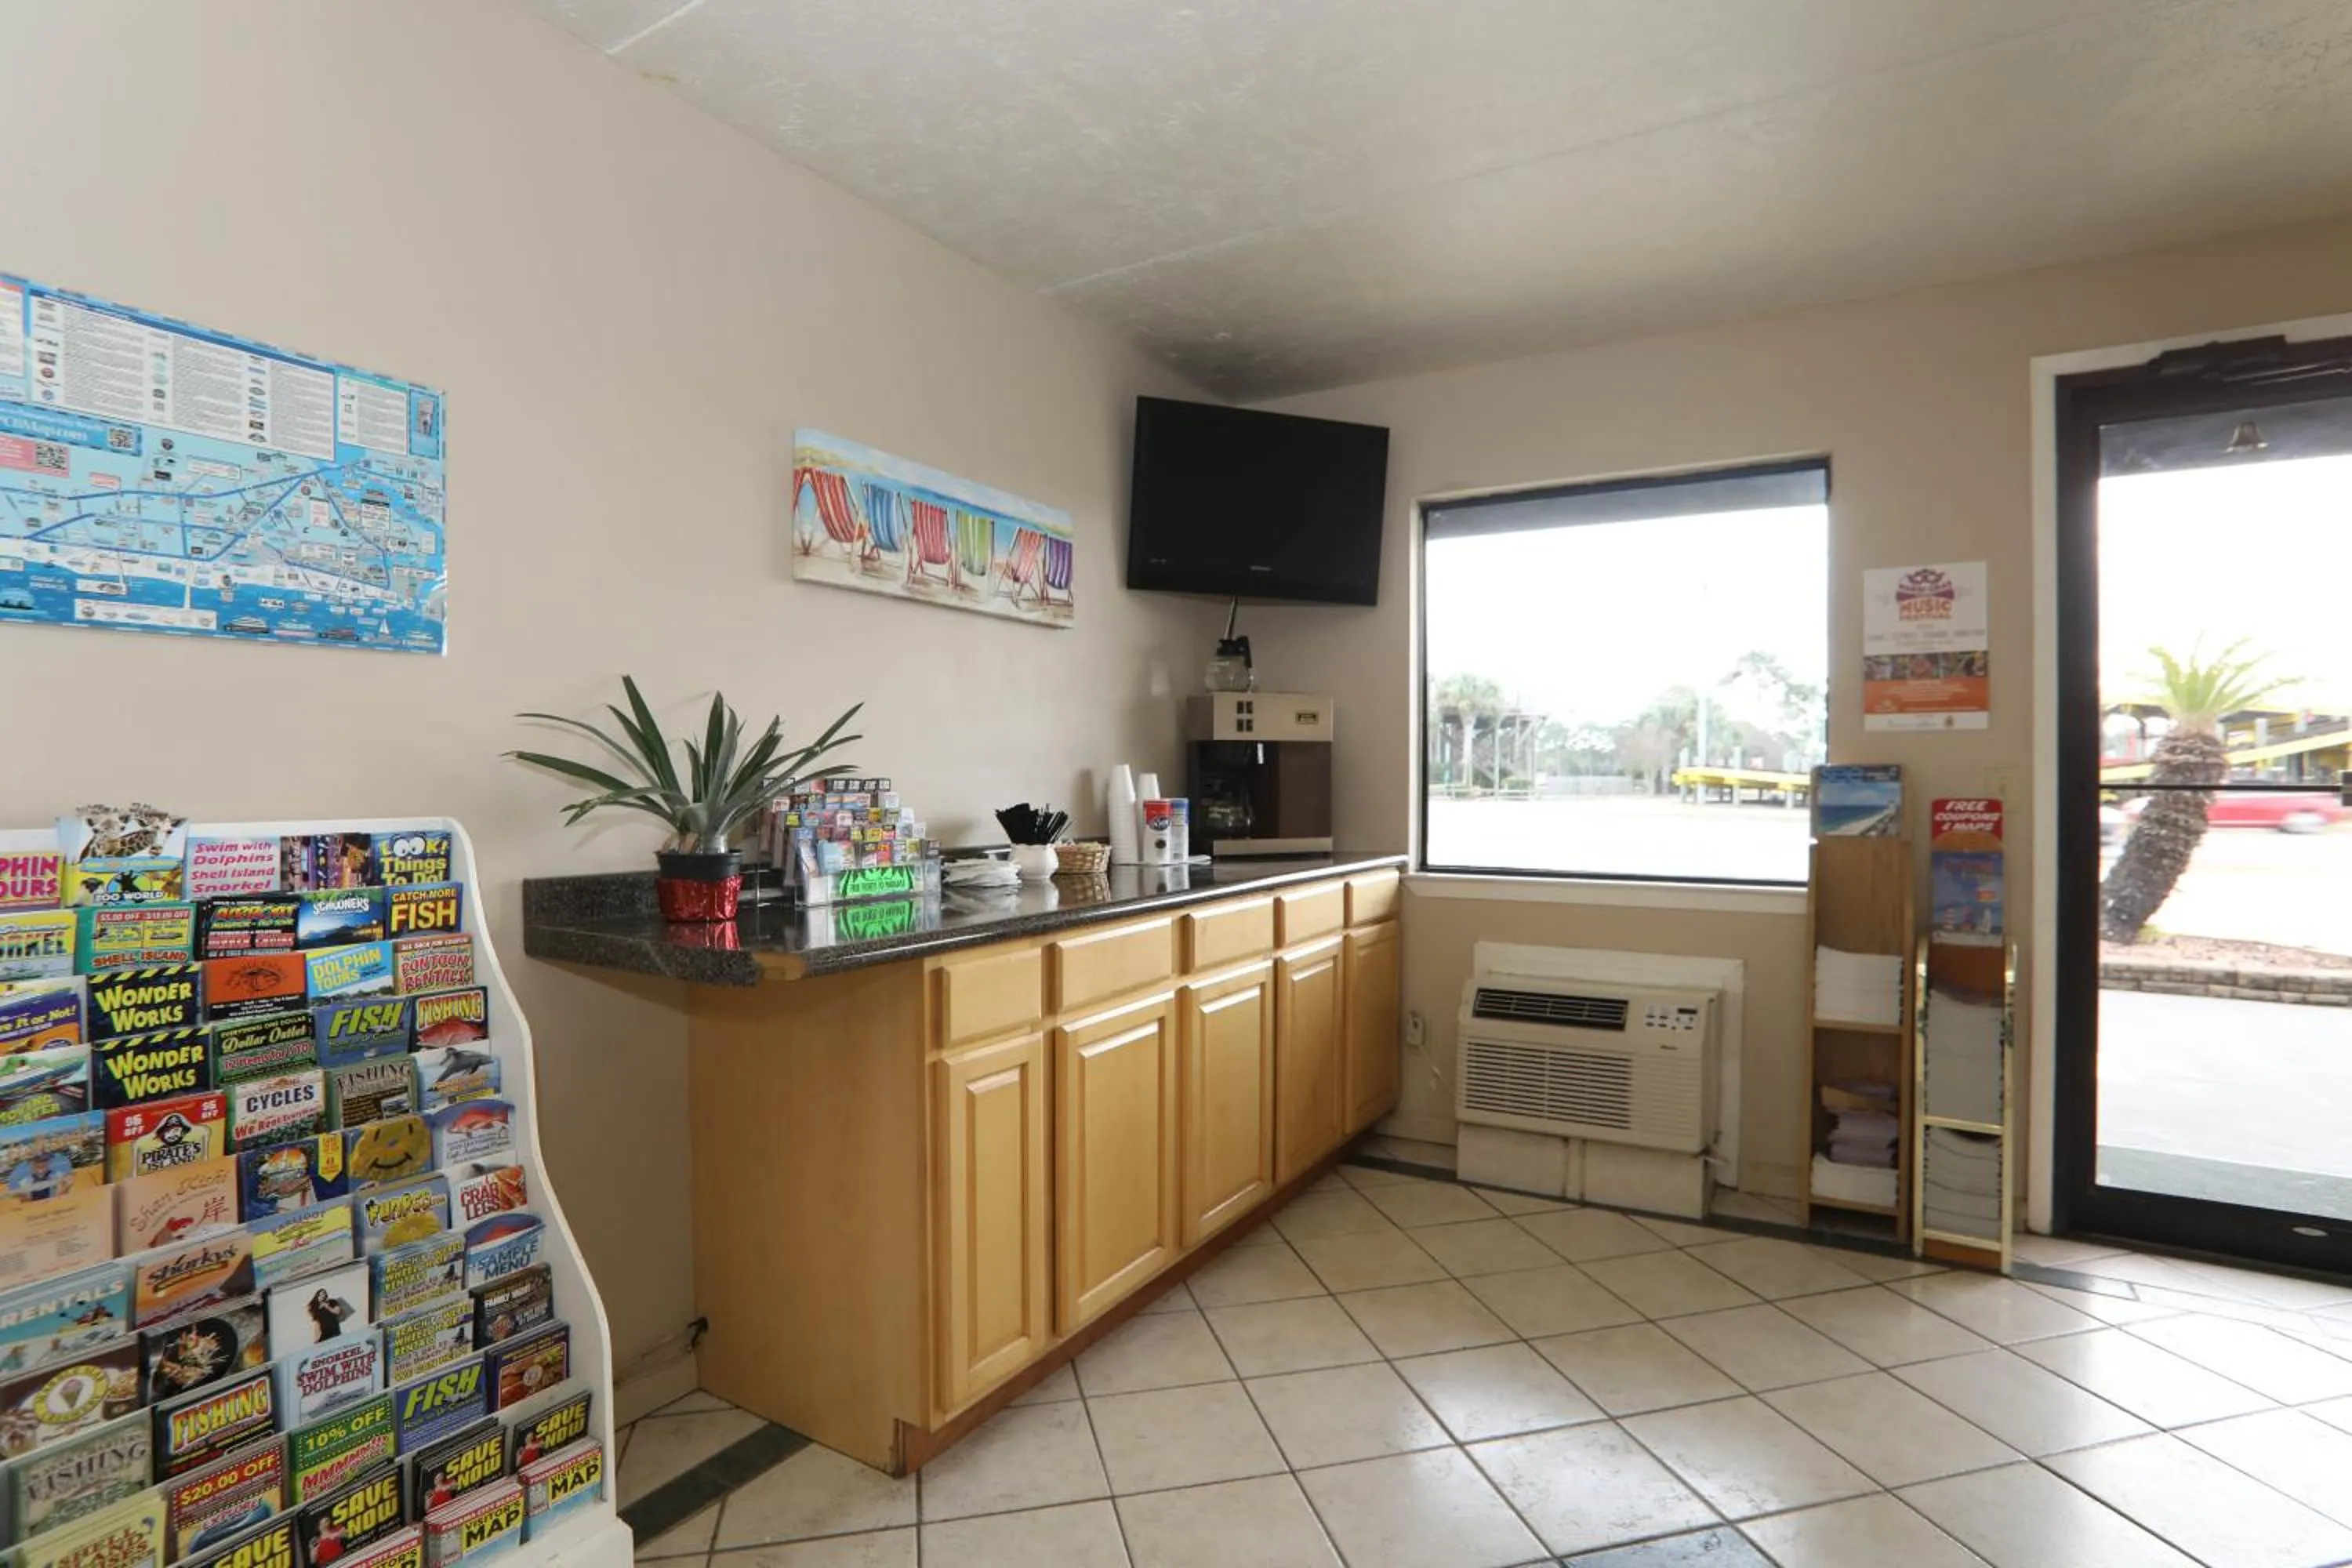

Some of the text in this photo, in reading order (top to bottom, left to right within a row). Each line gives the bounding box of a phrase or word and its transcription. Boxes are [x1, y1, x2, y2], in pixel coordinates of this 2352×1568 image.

[1934, 811, 2000, 821] COUPONS
[1945, 800, 1987, 811] FREE
[1952, 821, 1994, 830] MAPS
[193, 853, 274, 866] Dolphins
[196, 840, 271, 854] Swim with
[191, 866, 274, 880] Shell Island
[379, 857, 447, 873] Things
[380, 870, 443, 886] To Do!
[94, 891, 165, 905] ZOO WORLD
[192, 879, 270, 894] Snorkel
[394, 887, 456, 902] CATCH MORE
[313, 897, 370, 916] SCHOONERS
[391, 899, 456, 932] FISH
[92, 950, 188, 967] SHELL ISLAND
[312, 947, 381, 979] DOLPHIN
[401, 953, 470, 975] PONTOON
[314, 969, 360, 992] TOURS
[95, 982, 193, 1013] WONDER
[419, 993, 482, 1029] FISHING
[111, 1005, 183, 1033] WORKS
[328, 1002, 405, 1037] FISH
[223, 1025, 307, 1054] Dollar Outlet
[106, 1045, 205, 1080] WONDER
[122, 1069, 197, 1101] WORKS
[246, 1084, 314, 1113] CYCLES
[234, 1123, 256, 1139] We
[258, 1116, 281, 1131] Rent
[460, 1181, 501, 1206] CRAB
[129, 1192, 172, 1232] Shan
[465, 1199, 501, 1221] LEGS
[484, 1254, 531, 1280] MENU
[1, 1279, 126, 1328] RENTALS
[296, 1351, 378, 1388] SWIM WITH
[310, 1345, 365, 1370] SNORKEL
[300, 1362, 374, 1398] DOLPHINS
[402, 1365, 483, 1420] FISH
[173, 1378, 268, 1453] FISHING
[307, 1406, 387, 1450] 10% OFF
[534, 1400, 587, 1438] SAVE
[544, 1416, 586, 1450] NOW
[243, 1454, 276, 1477] OFF
[445, 1436, 503, 1479] SAVE
[457, 1454, 503, 1491] NOW
[550, 1463, 599, 1501] MAP
[332, 1474, 398, 1526] SAVE
[347, 1497, 398, 1538] NOW
[470, 1508, 521, 1546] MAP
